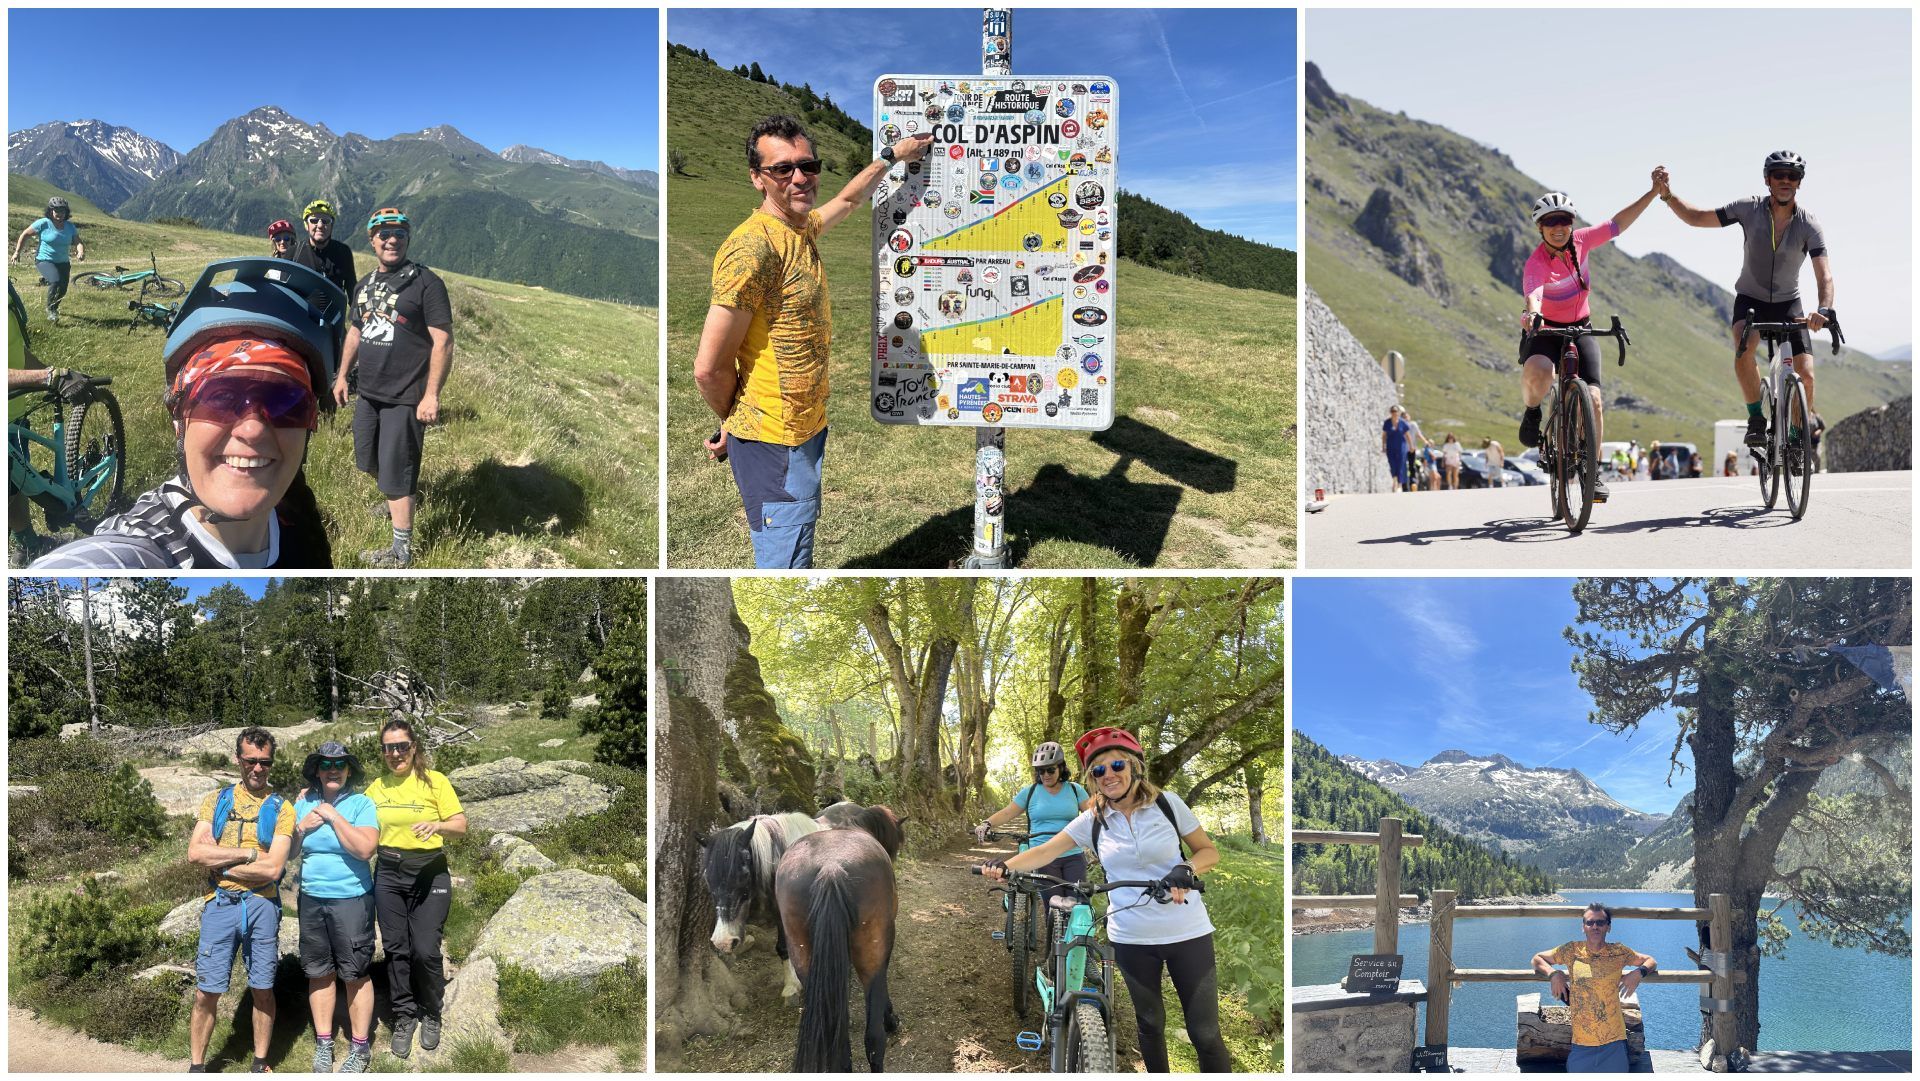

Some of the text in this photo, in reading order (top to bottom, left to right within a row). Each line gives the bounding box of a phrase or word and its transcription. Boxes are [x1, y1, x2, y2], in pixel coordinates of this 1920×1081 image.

[974, 94, 984, 102] DE
[1004, 93, 1030, 102] ROUTE
[995, 101, 1040, 110] HISTORIQUE
[932, 123, 1060, 145] COL D'ASPIN
[959, 361, 1036, 370] SAINTE-MARIE-DE-CAMPAN
[997, 393, 1038, 404] STRAVA
[1353, 957, 1385, 968] Service
[1354, 968, 1391, 981] Comptoir
